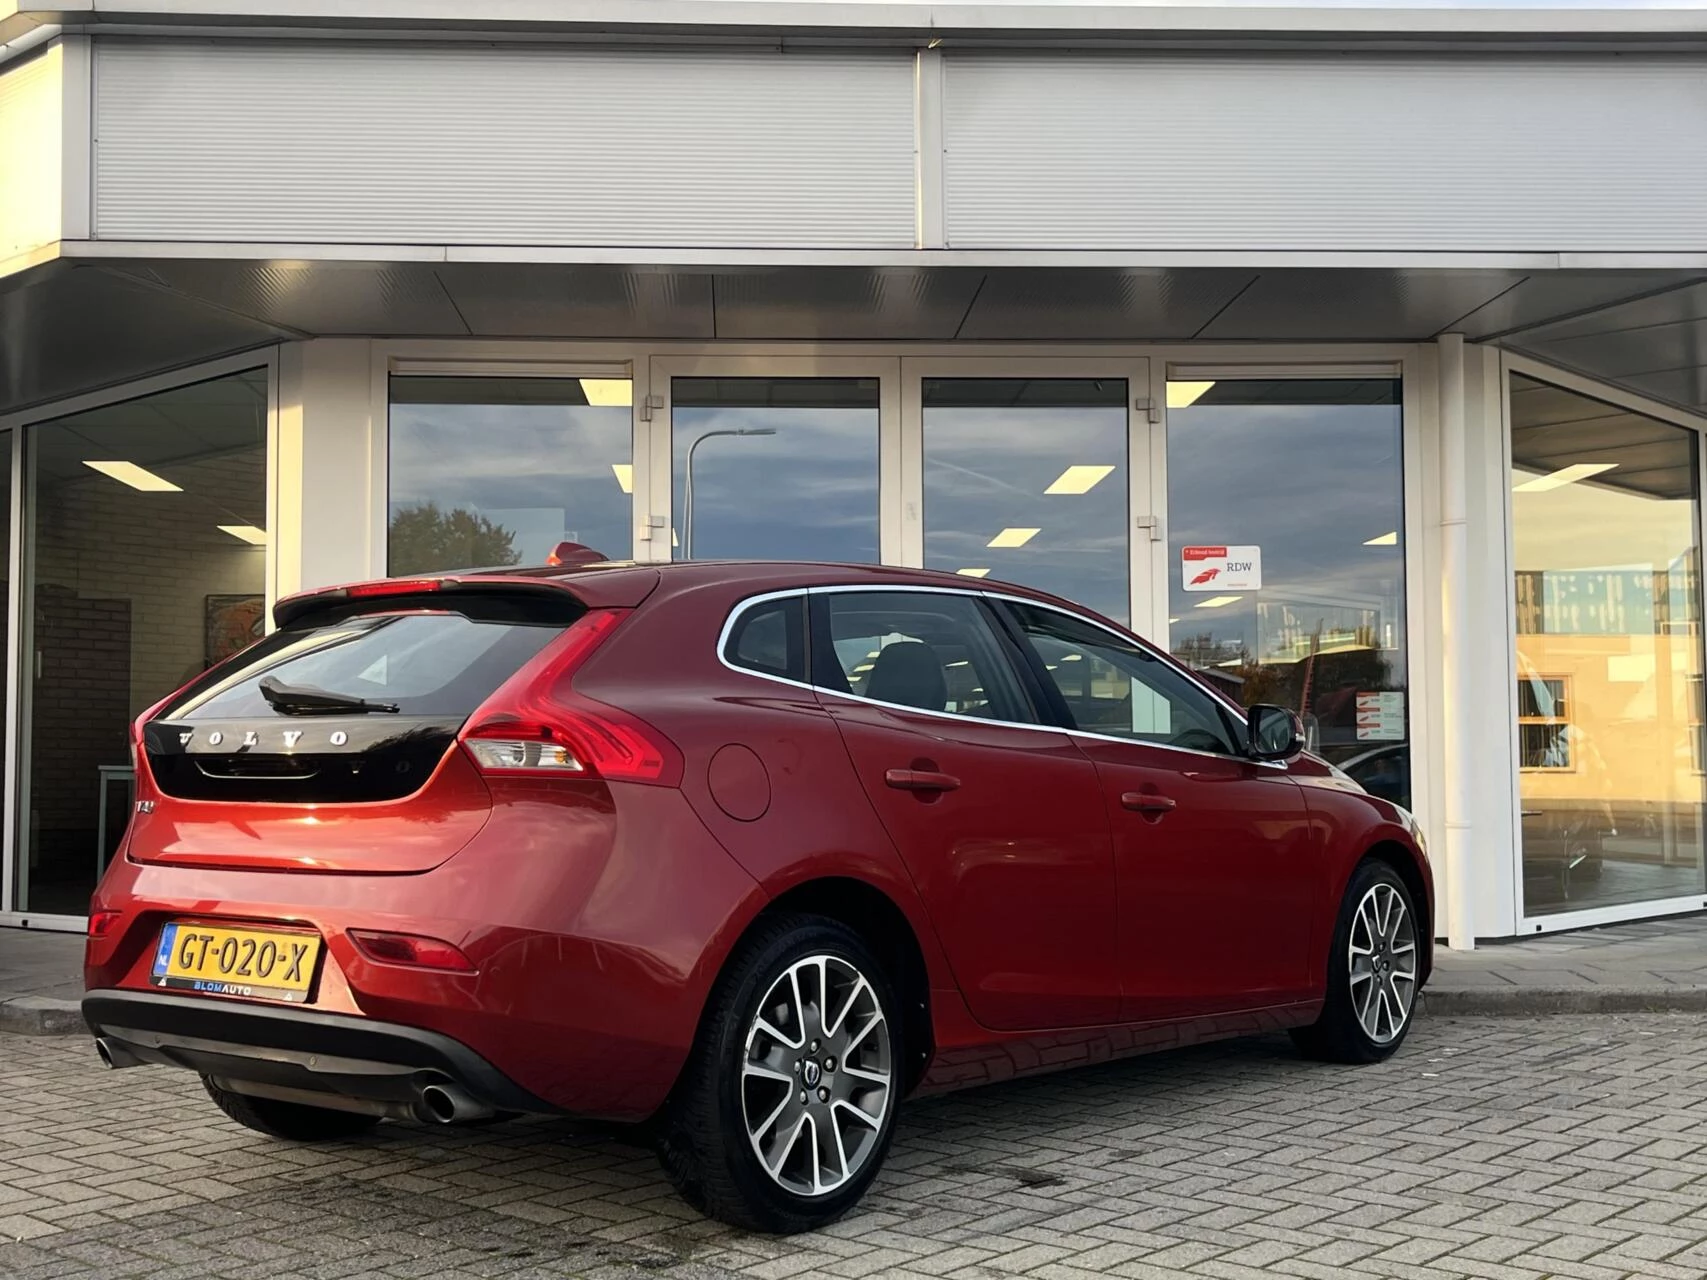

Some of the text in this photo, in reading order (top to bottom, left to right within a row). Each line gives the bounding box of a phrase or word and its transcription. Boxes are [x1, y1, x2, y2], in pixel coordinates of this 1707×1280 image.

[1226, 562, 1252, 572] RDW
[179, 731, 348, 747] VOLVO
[158, 954, 168, 966] NL
[178, 933, 308, 982] GT-020-X
[194, 981, 252, 996] BLOMAUTO
